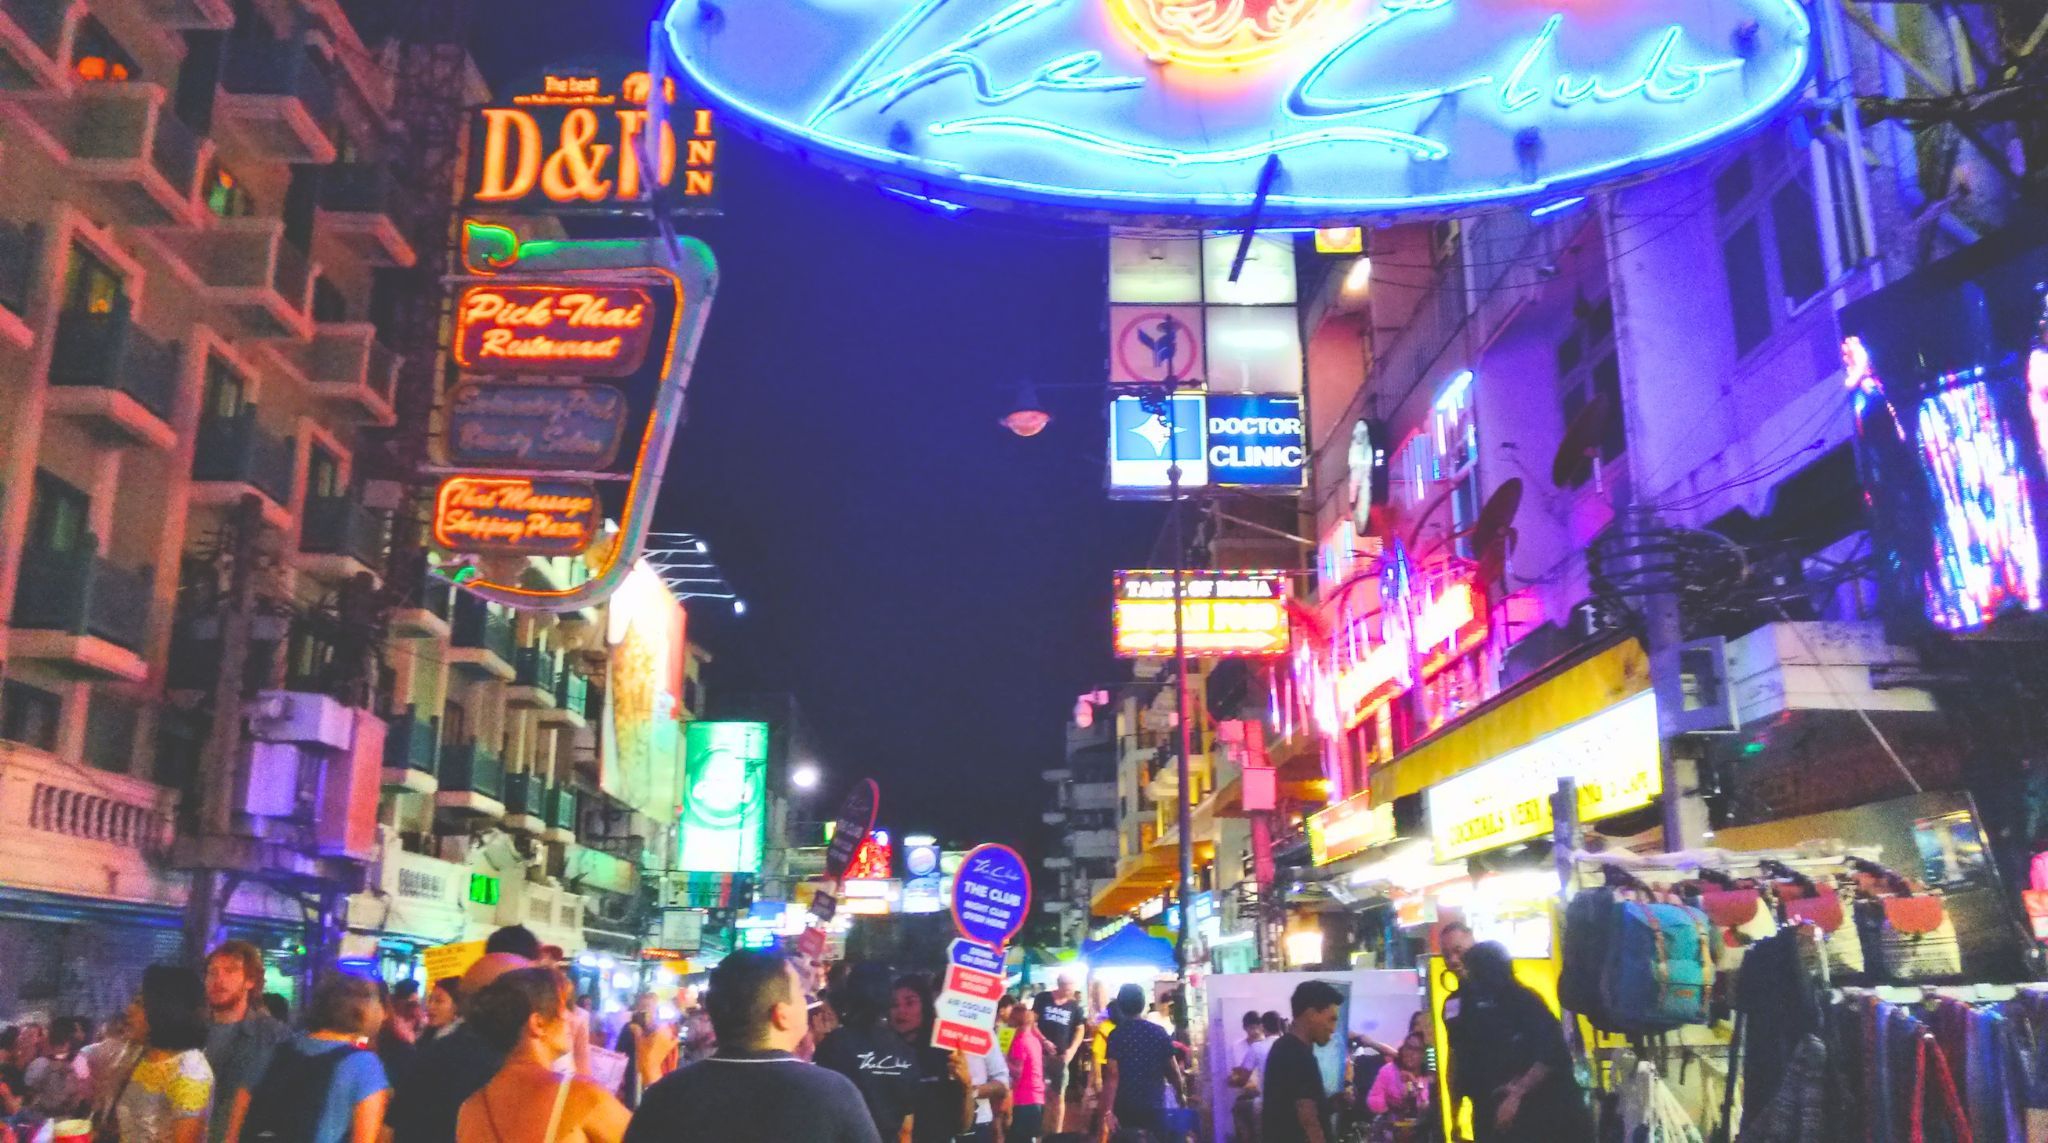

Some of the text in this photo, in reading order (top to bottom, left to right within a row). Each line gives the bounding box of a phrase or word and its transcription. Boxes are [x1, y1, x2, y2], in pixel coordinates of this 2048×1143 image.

[1284, 0, 1747, 122] Club
[683, 109, 717, 196] INN
[465, 293, 644, 328] Pick-Thai
[479, 328, 623, 359] Restaurant
[1209, 417, 1301, 436] DOCTOR
[1209, 445, 1301, 468] CLINIC
[451, 484, 594, 519] Thai Massage
[445, 509, 585, 544] Shopping Plaza
[1188, 580, 1214, 597] OF
[964, 881, 1021, 907] THE CLUB
